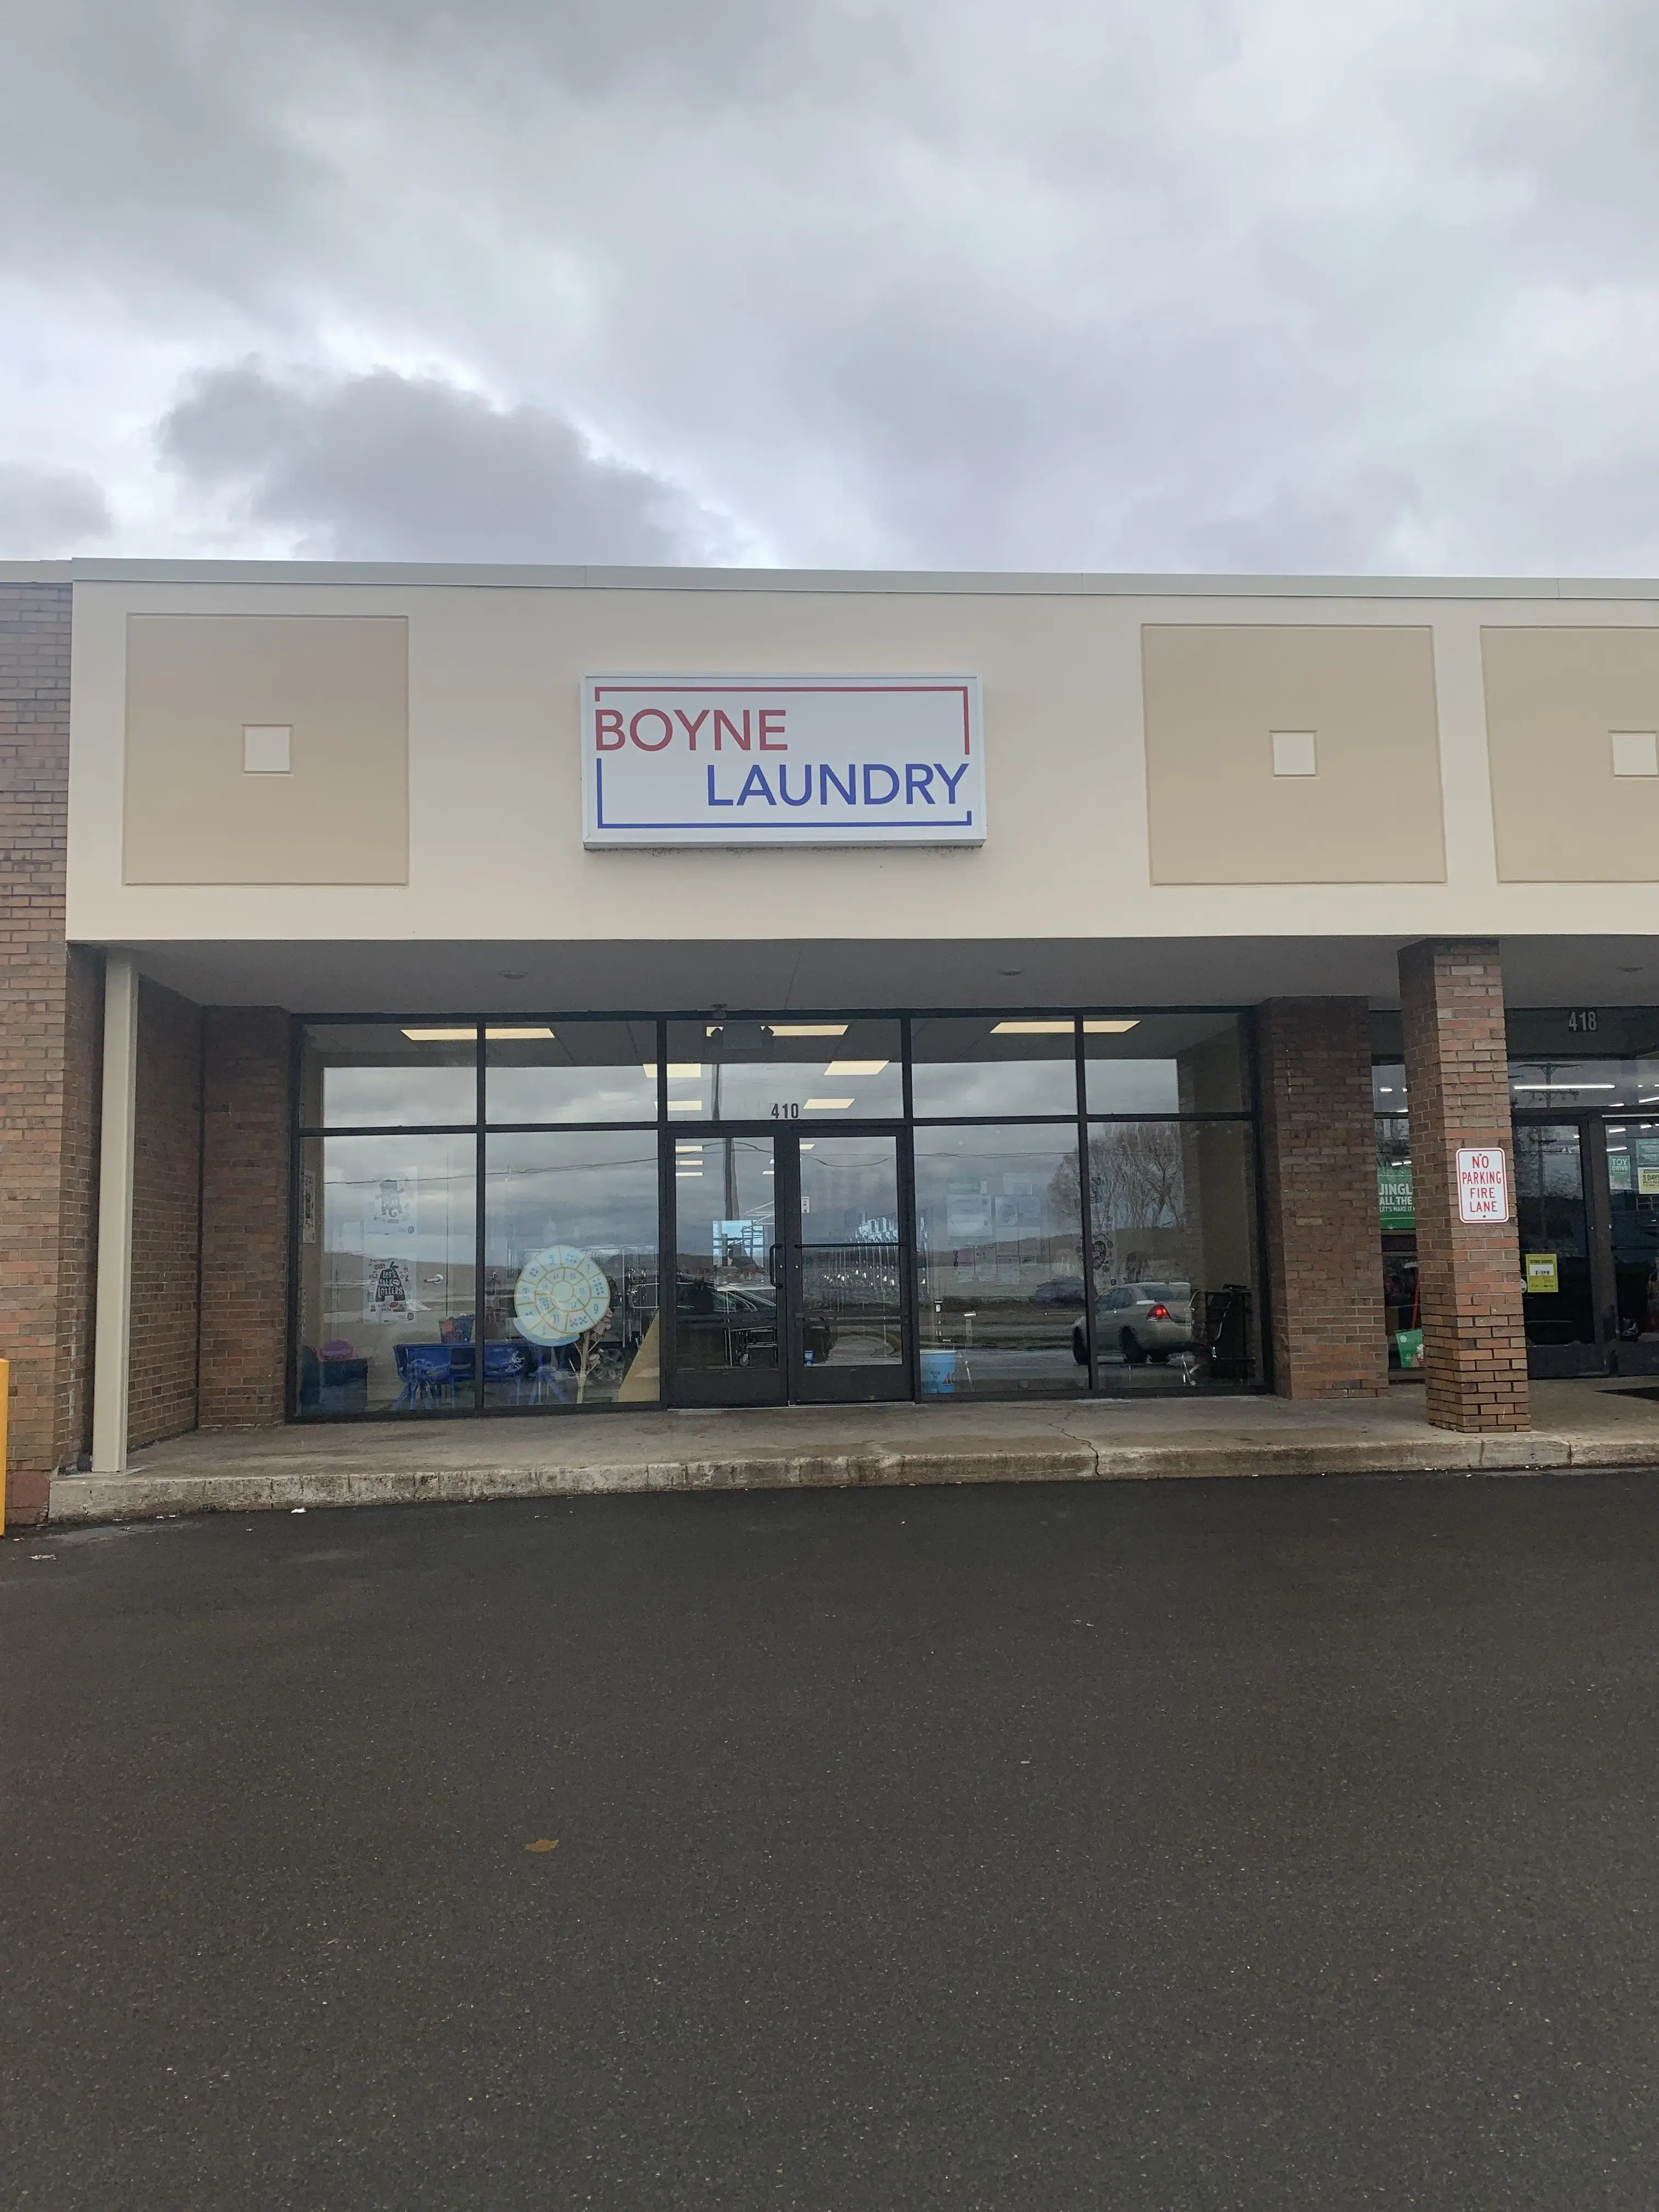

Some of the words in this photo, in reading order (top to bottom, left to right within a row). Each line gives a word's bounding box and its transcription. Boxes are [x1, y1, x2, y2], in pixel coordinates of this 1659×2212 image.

[595, 708, 788, 751] BOYNE
[708, 763, 969, 805] LAUNDRY
[1568, 1011, 1597, 1031] 418
[771, 1103, 799, 1119] 410
[1472, 1155, 1489, 1169] NO
[1462, 1171, 1502, 1184] PARKING
[1379, 1183, 1412, 1195] JINGL
[1470, 1187, 1496, 1199] FIRE
[1379, 1197, 1395, 1205] ALL
[1396, 1197, 1412, 1205] THE
[1470, 1201, 1498, 1212] LANE
[586, 1264, 590, 1274] 7
[593, 1304, 599, 1315] 9
